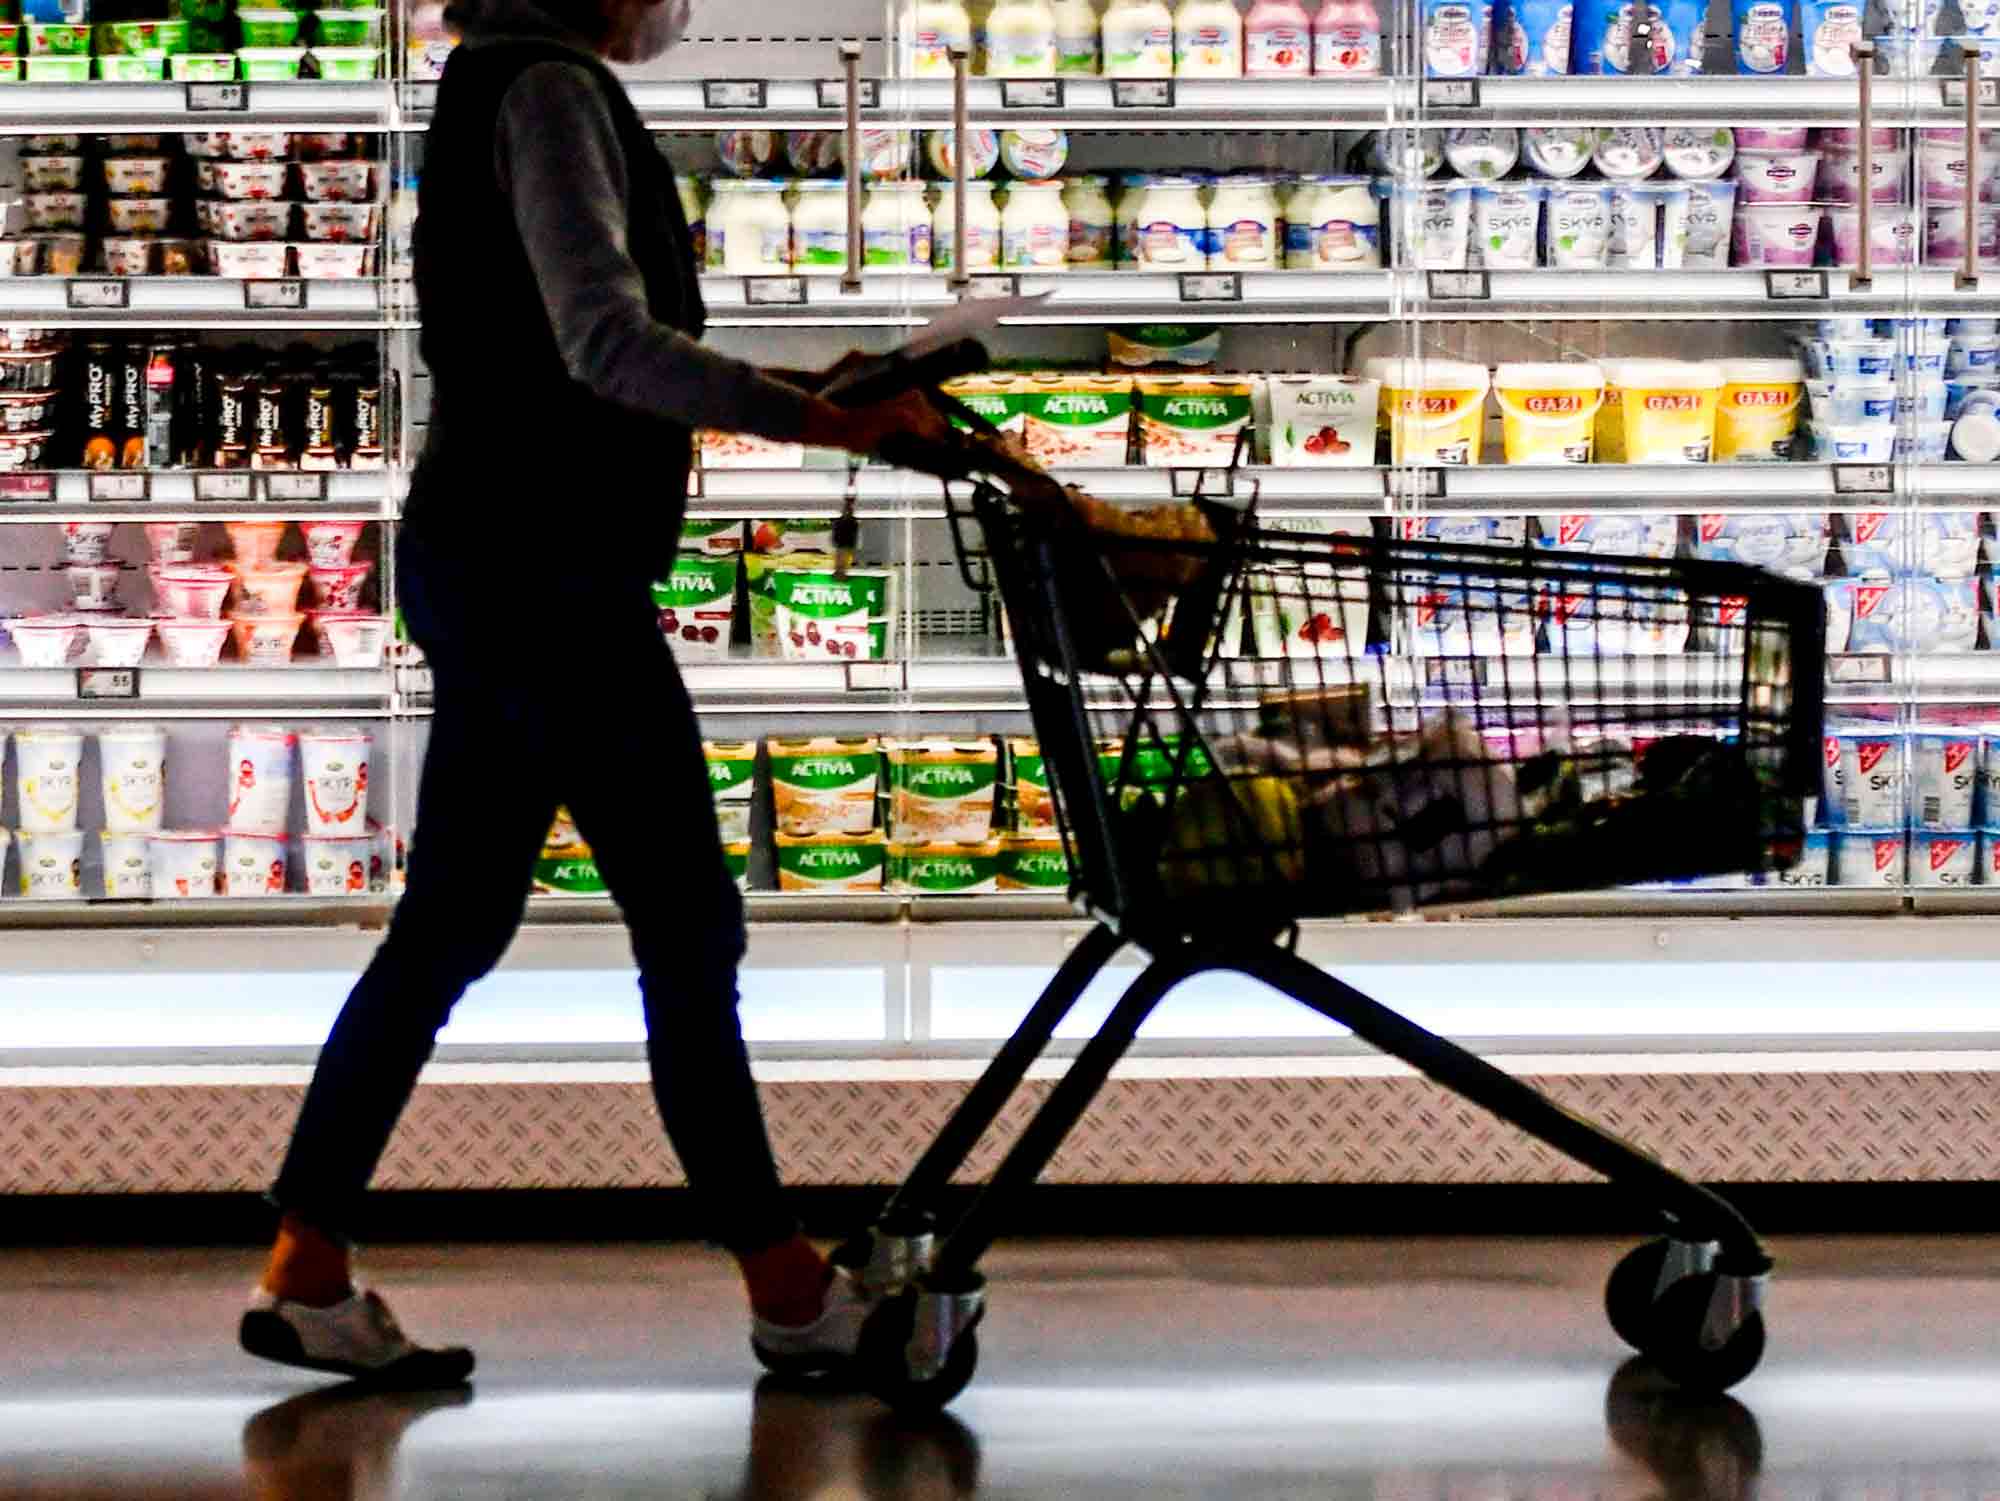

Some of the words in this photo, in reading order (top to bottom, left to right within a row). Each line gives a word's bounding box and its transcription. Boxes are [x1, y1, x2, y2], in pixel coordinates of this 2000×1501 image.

[1043, 396, 1109, 415] ACTIVIA
[1295, 391, 1355, 405] ACTIVIA
[1530, 398, 1579, 411] GAZI
[1648, 396, 1699, 411] GAZI
[1738, 392, 1786, 406] GAZI
[1163, 399, 1229, 417] ACTIVIA
[789, 588, 853, 606] ACTIVIA
[791, 761, 855, 777] ACTIVIA
[911, 766, 975, 784] ACTIVIA
[798, 851, 861, 867] ACTIVIA
[911, 862, 975, 879] ACTIVIA
